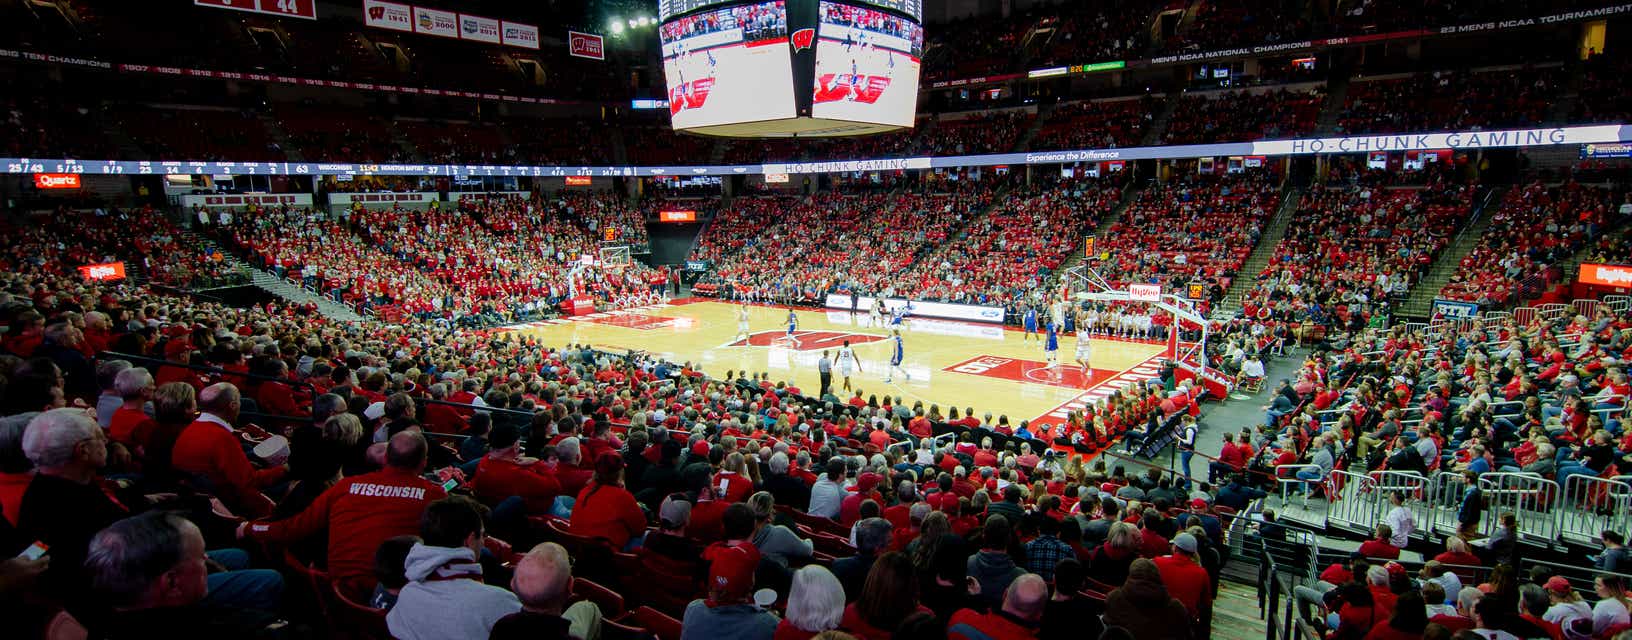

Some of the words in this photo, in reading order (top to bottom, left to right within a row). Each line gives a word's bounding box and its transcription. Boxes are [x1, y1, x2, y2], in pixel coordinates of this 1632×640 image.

[1458, 23, 1496, 33] MEN'S
[1498, 18, 1535, 29] NCAA
[1538, 4, 1632, 24] TOURNAMENT
[1179, 52, 1204, 62] NCAA
[1205, 48, 1249, 59] NATIONAL
[1254, 42, 1311, 54] CHAMPIONS
[1326, 37, 1351, 45] 1941
[22, 52, 46, 60] TEN
[48, 55, 111, 69] CHAMPIONS
[1292, 134, 1429, 153] HO-CHUNK
[1445, 129, 1567, 148] GAMING
[856, 158, 908, 170] GAMING
[1027, 153, 1065, 163] Experience
[1066, 153, 1079, 161] the
[1080, 150, 1119, 160] Difference
[296, 165, 309, 174] 63
[41, 175, 76, 186] Quartz
[349, 483, 427, 500] WISCONSIN
